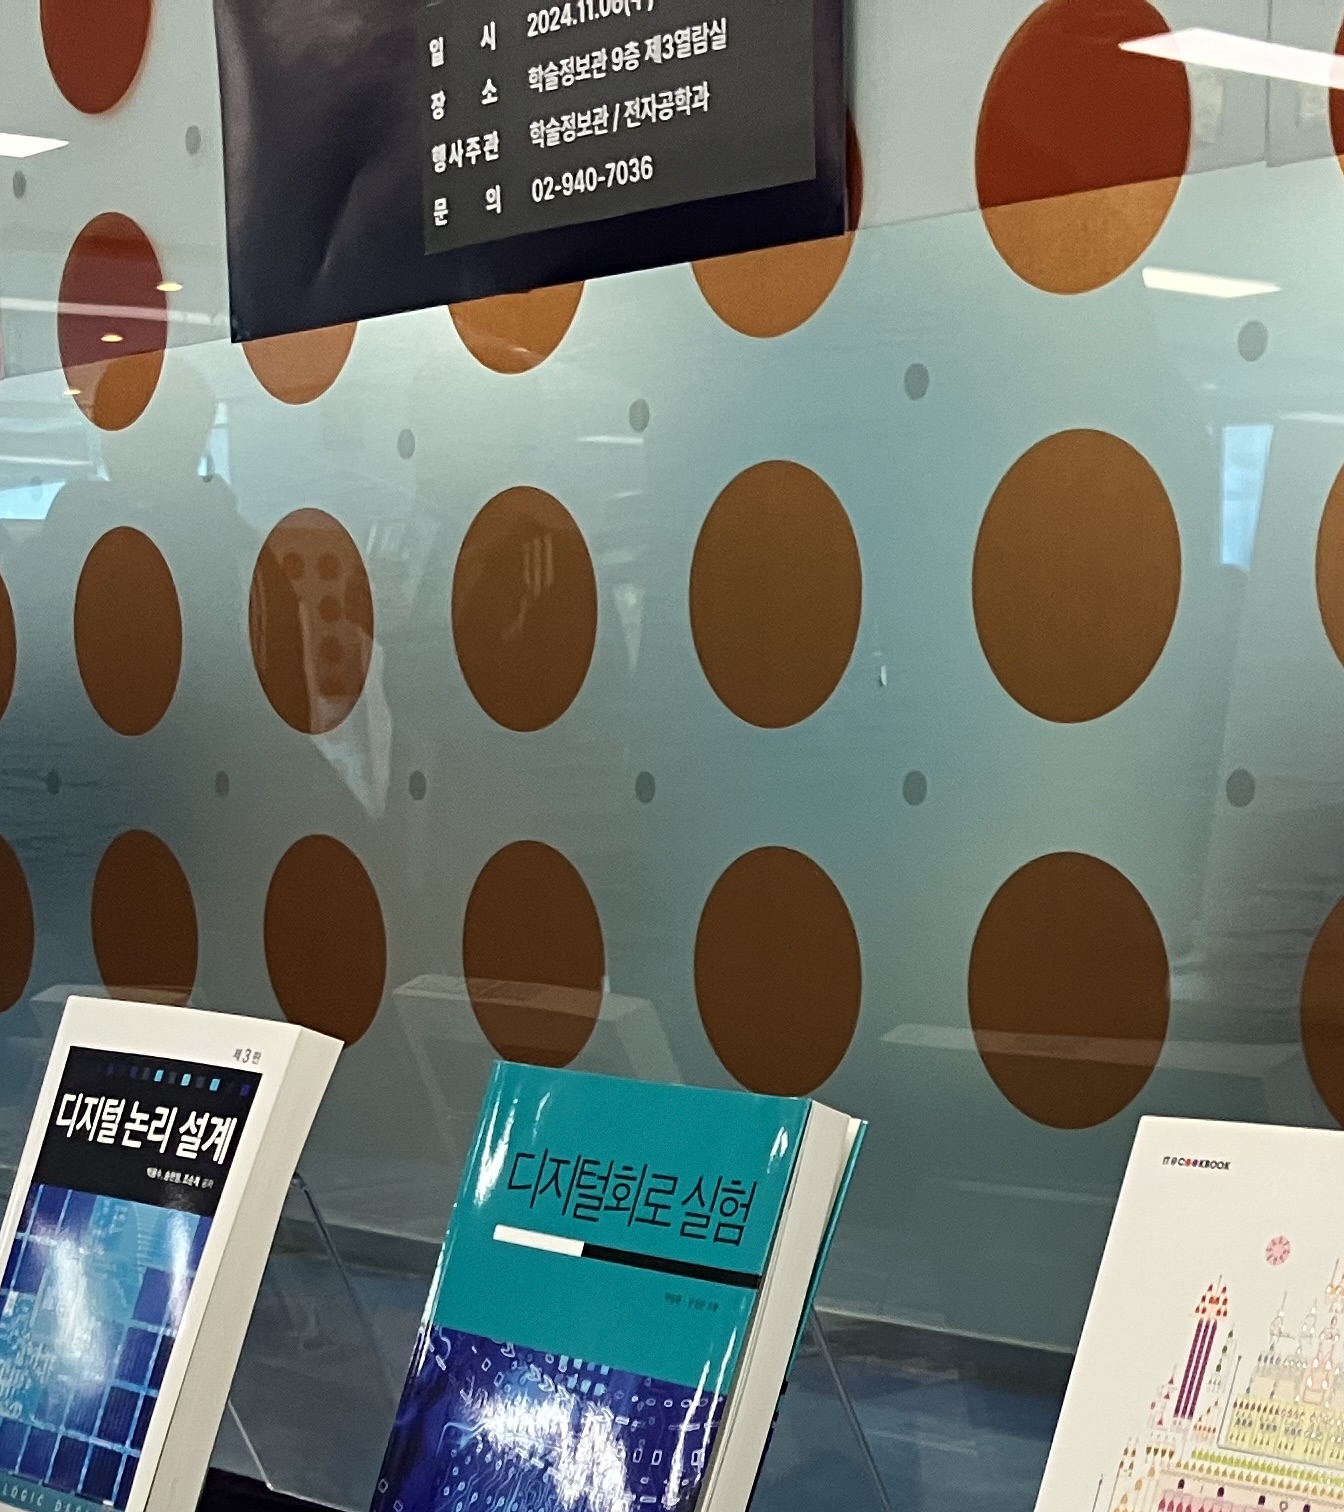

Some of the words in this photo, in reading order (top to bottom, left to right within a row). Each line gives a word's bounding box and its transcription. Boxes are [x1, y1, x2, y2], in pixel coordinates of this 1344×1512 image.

[428, 37, 445, 68] 일
[480, 22, 497, 52] 시
[430, 90, 447, 121] 장
[480, 77, 499, 106] 소
[528, 43, 609, 92] 학술정보관
[611, 39, 642, 73] 9층
[642, 16, 728, 64] 제3열람실
[431, 130, 500, 174] 행사주관
[529, 104, 610, 150] 학술정보관
[622, 81, 711, 130] 전자공학과
[433, 195, 450, 227] 문
[484, 183, 503, 216] 의
[531, 153, 655, 204] 02-940-7036
[56, 1091, 124, 1147] 디지털
[123, 1100, 179, 1154] 논리
[175, 1110, 238, 1165] 설계
[677, 1176, 757, 1247] 실험
[2, 1483, 44, 1507] LOGIC
